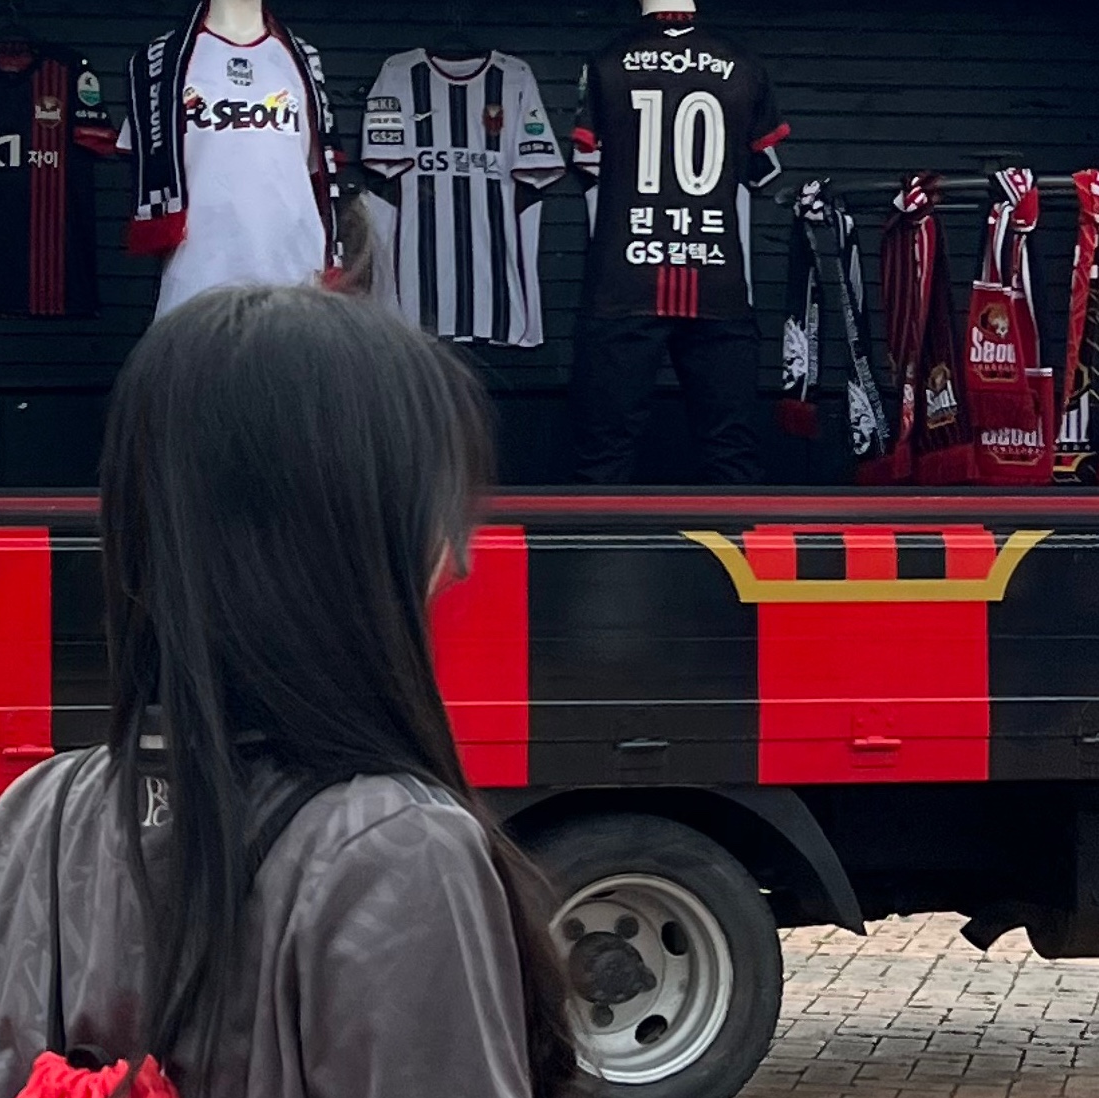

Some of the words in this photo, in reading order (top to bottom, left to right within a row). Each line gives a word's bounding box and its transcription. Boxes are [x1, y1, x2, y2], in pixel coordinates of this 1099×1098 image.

[698, 52, 735, 80] Pay
[631, 89, 726, 196] 10
[417, 150, 450, 171] GS
[625, 240, 664, 265] GS
